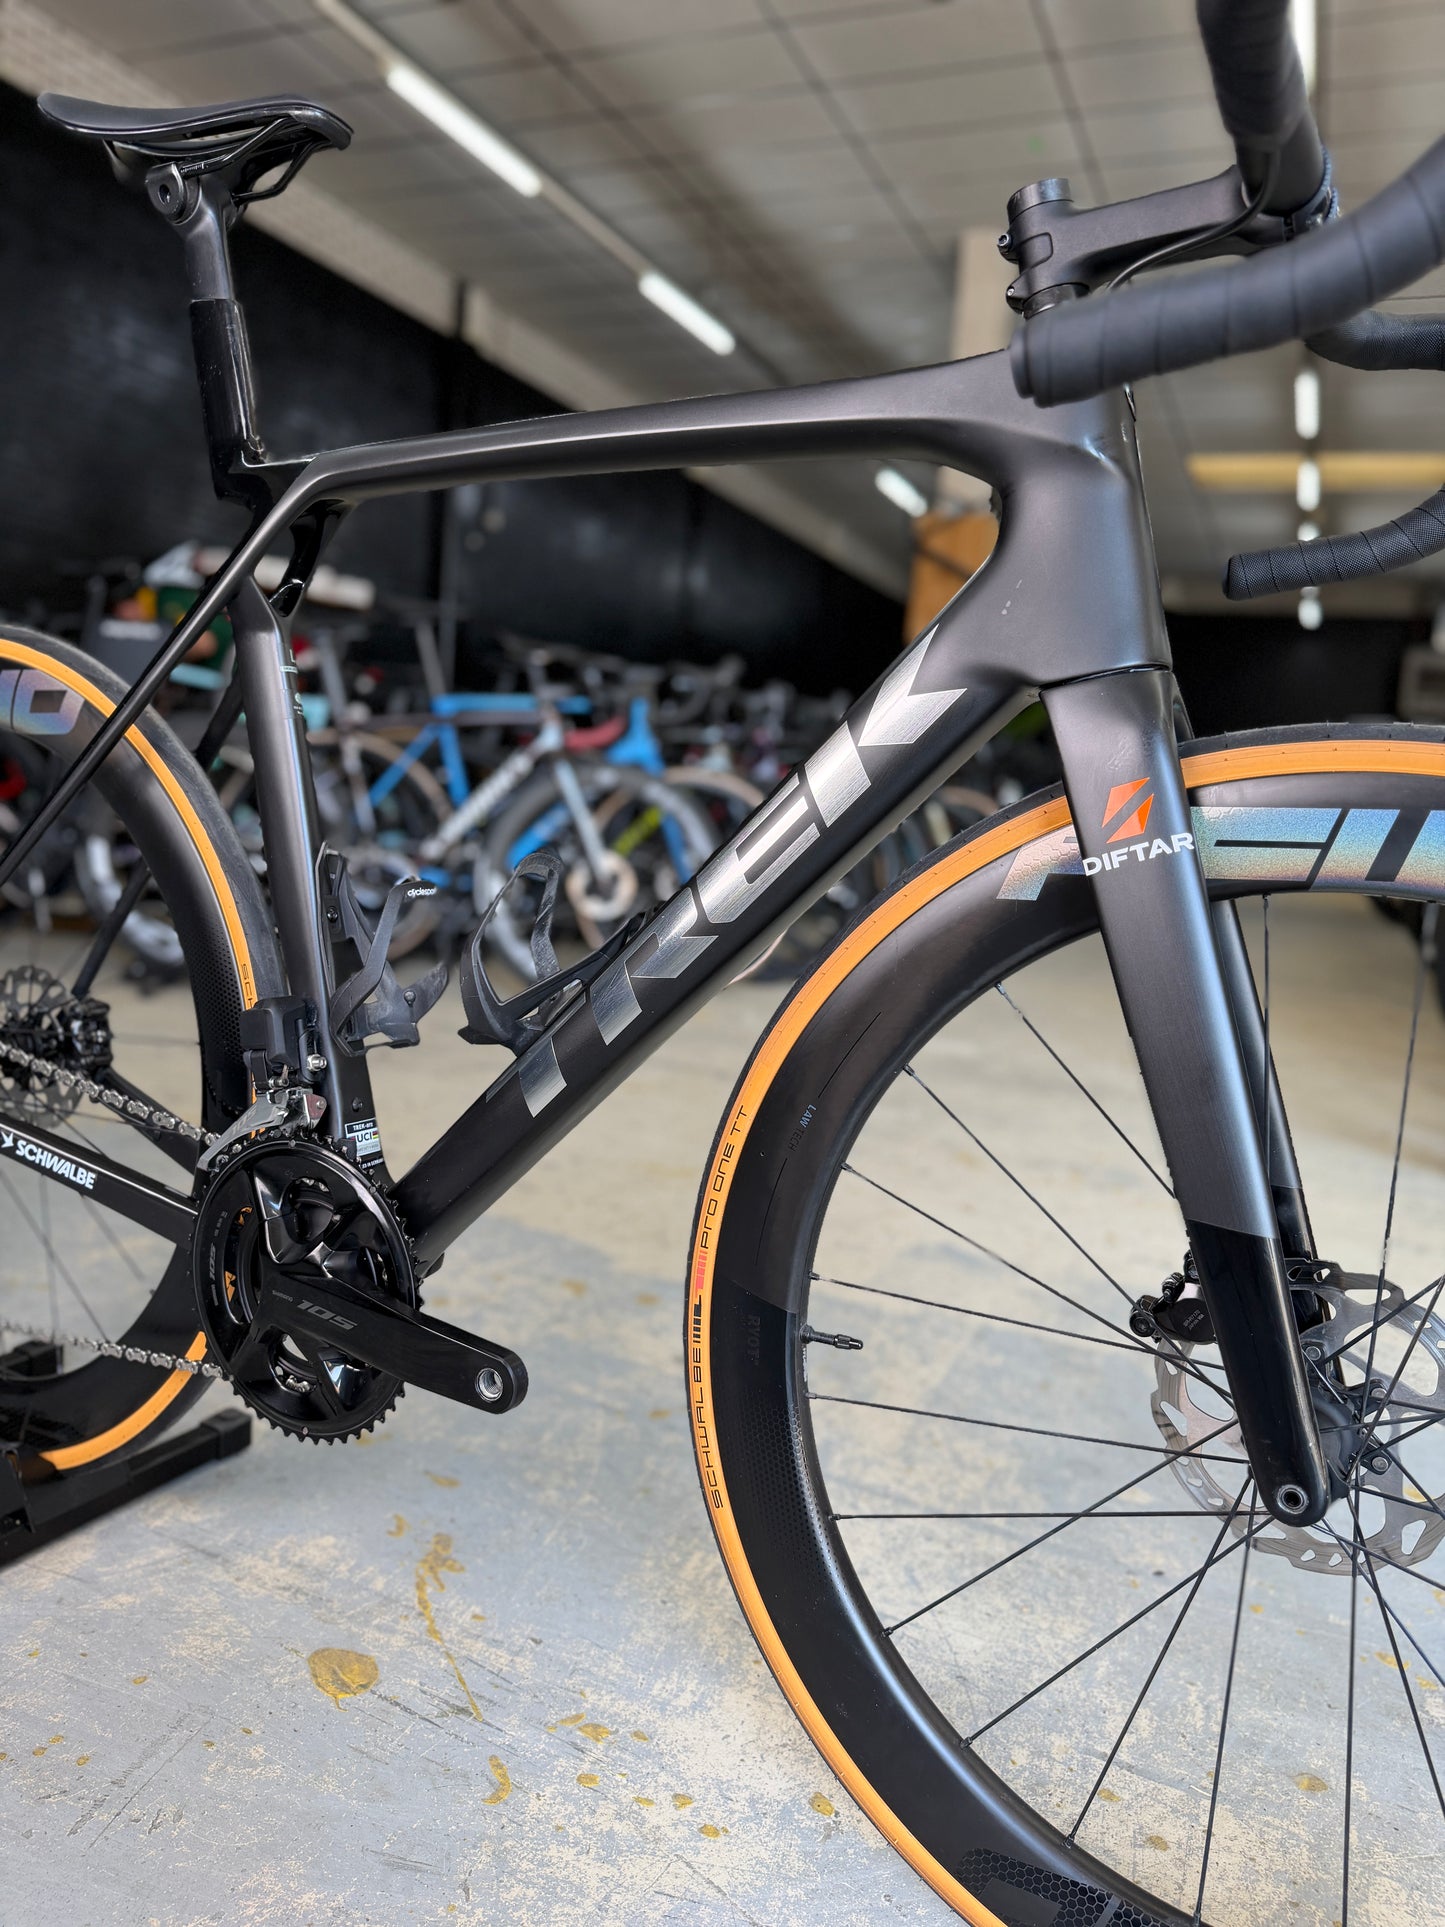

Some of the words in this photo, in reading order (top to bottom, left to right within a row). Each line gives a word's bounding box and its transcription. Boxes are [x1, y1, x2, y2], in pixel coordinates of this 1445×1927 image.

[485, 623, 967, 1118] TREK
[1082, 831, 1196, 877] DIFTAR
[356, 1132, 373, 1143] UCI
[729, 1104, 748, 1134] TT
[15, 1139, 96, 1190] SCHWALBE
[713, 1143, 736, 1192] ONE
[701, 1198, 718, 1250] PRO
[296, 1299, 358, 1331] 105
[692, 1347, 725, 1510] SCHWALBE
